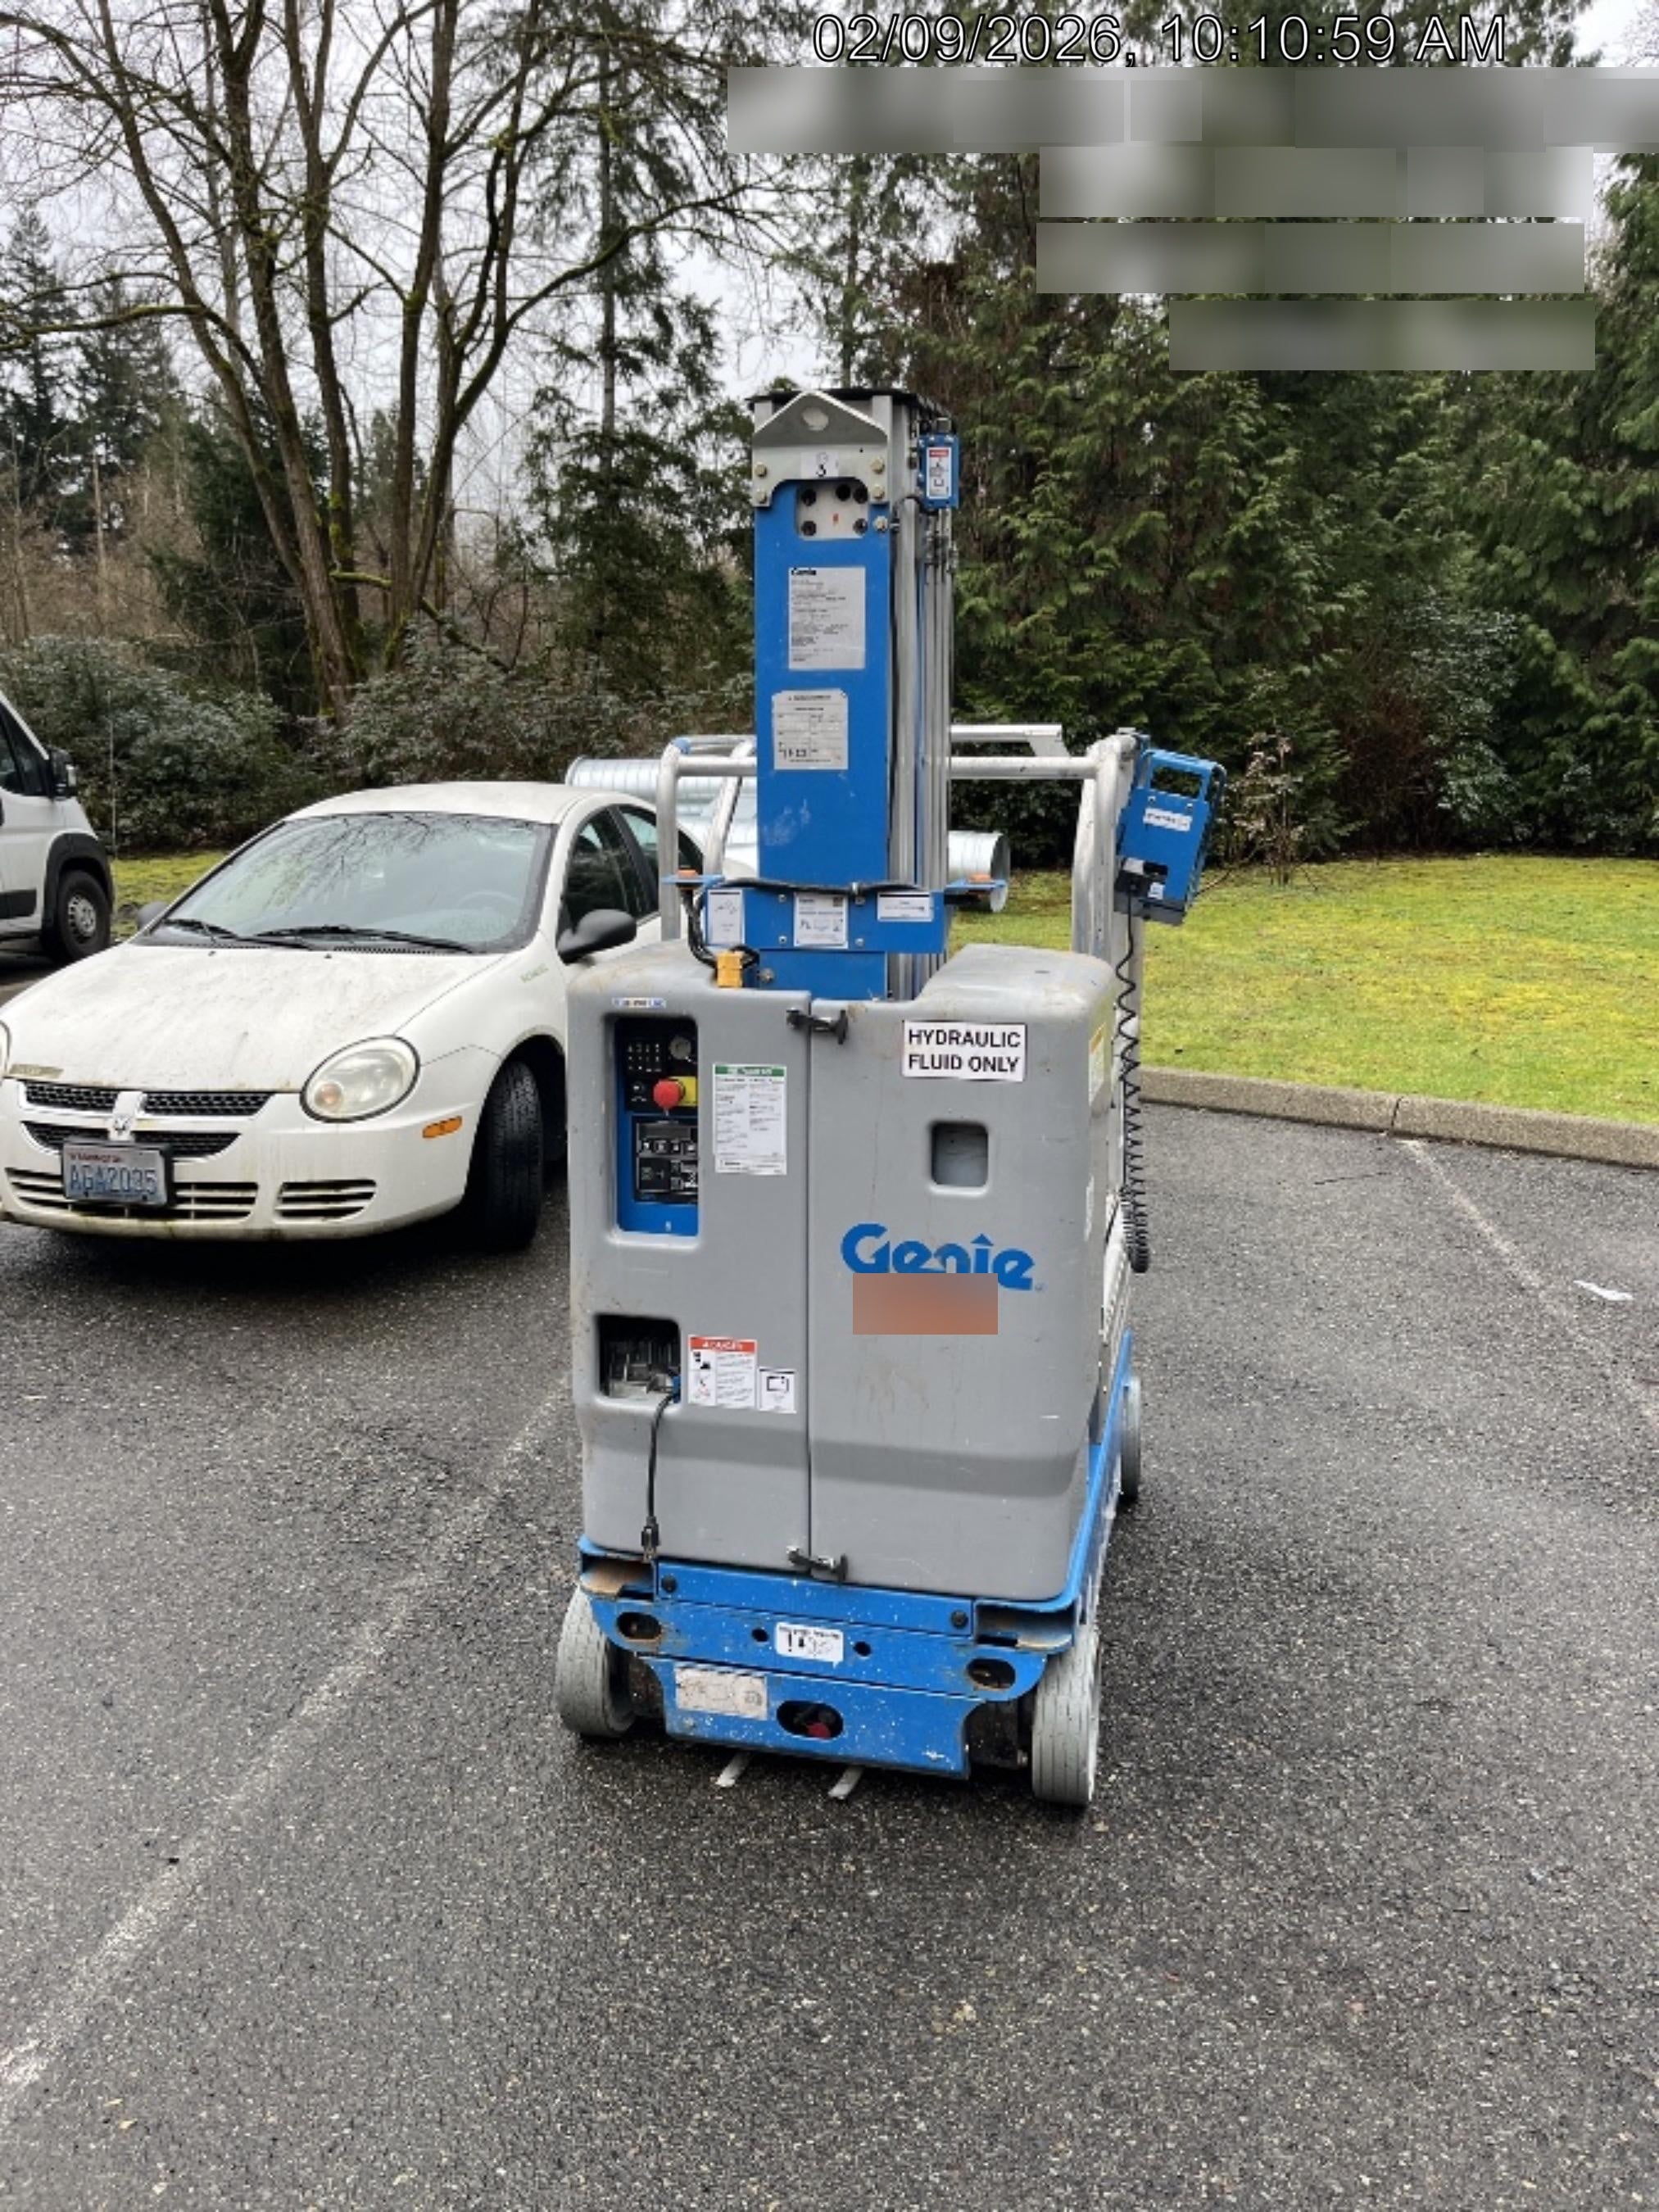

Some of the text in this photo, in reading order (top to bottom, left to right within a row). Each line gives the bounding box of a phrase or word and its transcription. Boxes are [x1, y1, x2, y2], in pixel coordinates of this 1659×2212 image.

[908, 1029, 1022, 1048] HYDRAULIC
[908, 1054, 1020, 1073] FLUID ONLY
[841, 1222, 1035, 1291] Genie
